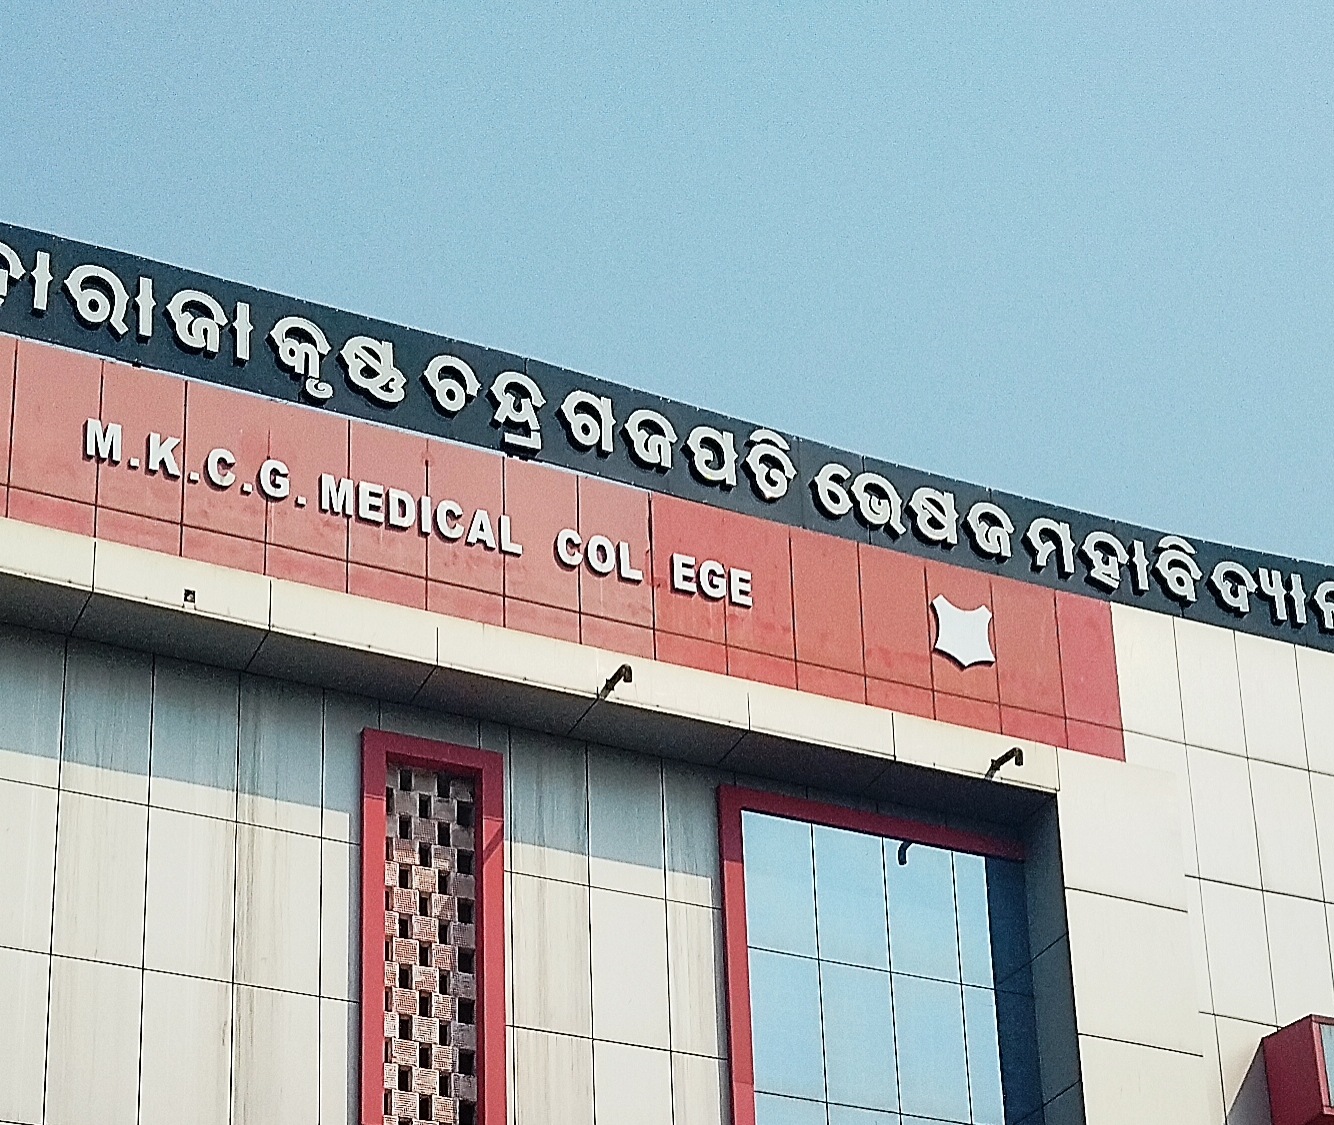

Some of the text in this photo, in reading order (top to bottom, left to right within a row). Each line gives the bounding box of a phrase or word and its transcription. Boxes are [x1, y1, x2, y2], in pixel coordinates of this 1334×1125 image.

[83, 417, 308, 506] M.K.C.G.
[319, 472, 523, 555] MEDICAL
[270, 315, 407, 404] କୃଷ୍ଣ
[423, 354, 547, 451] ଚନ୍ଦ୍ର
[561, 389, 798, 500] ଗଜପତି
[815, 462, 1015, 559] ଭେଷଜ
